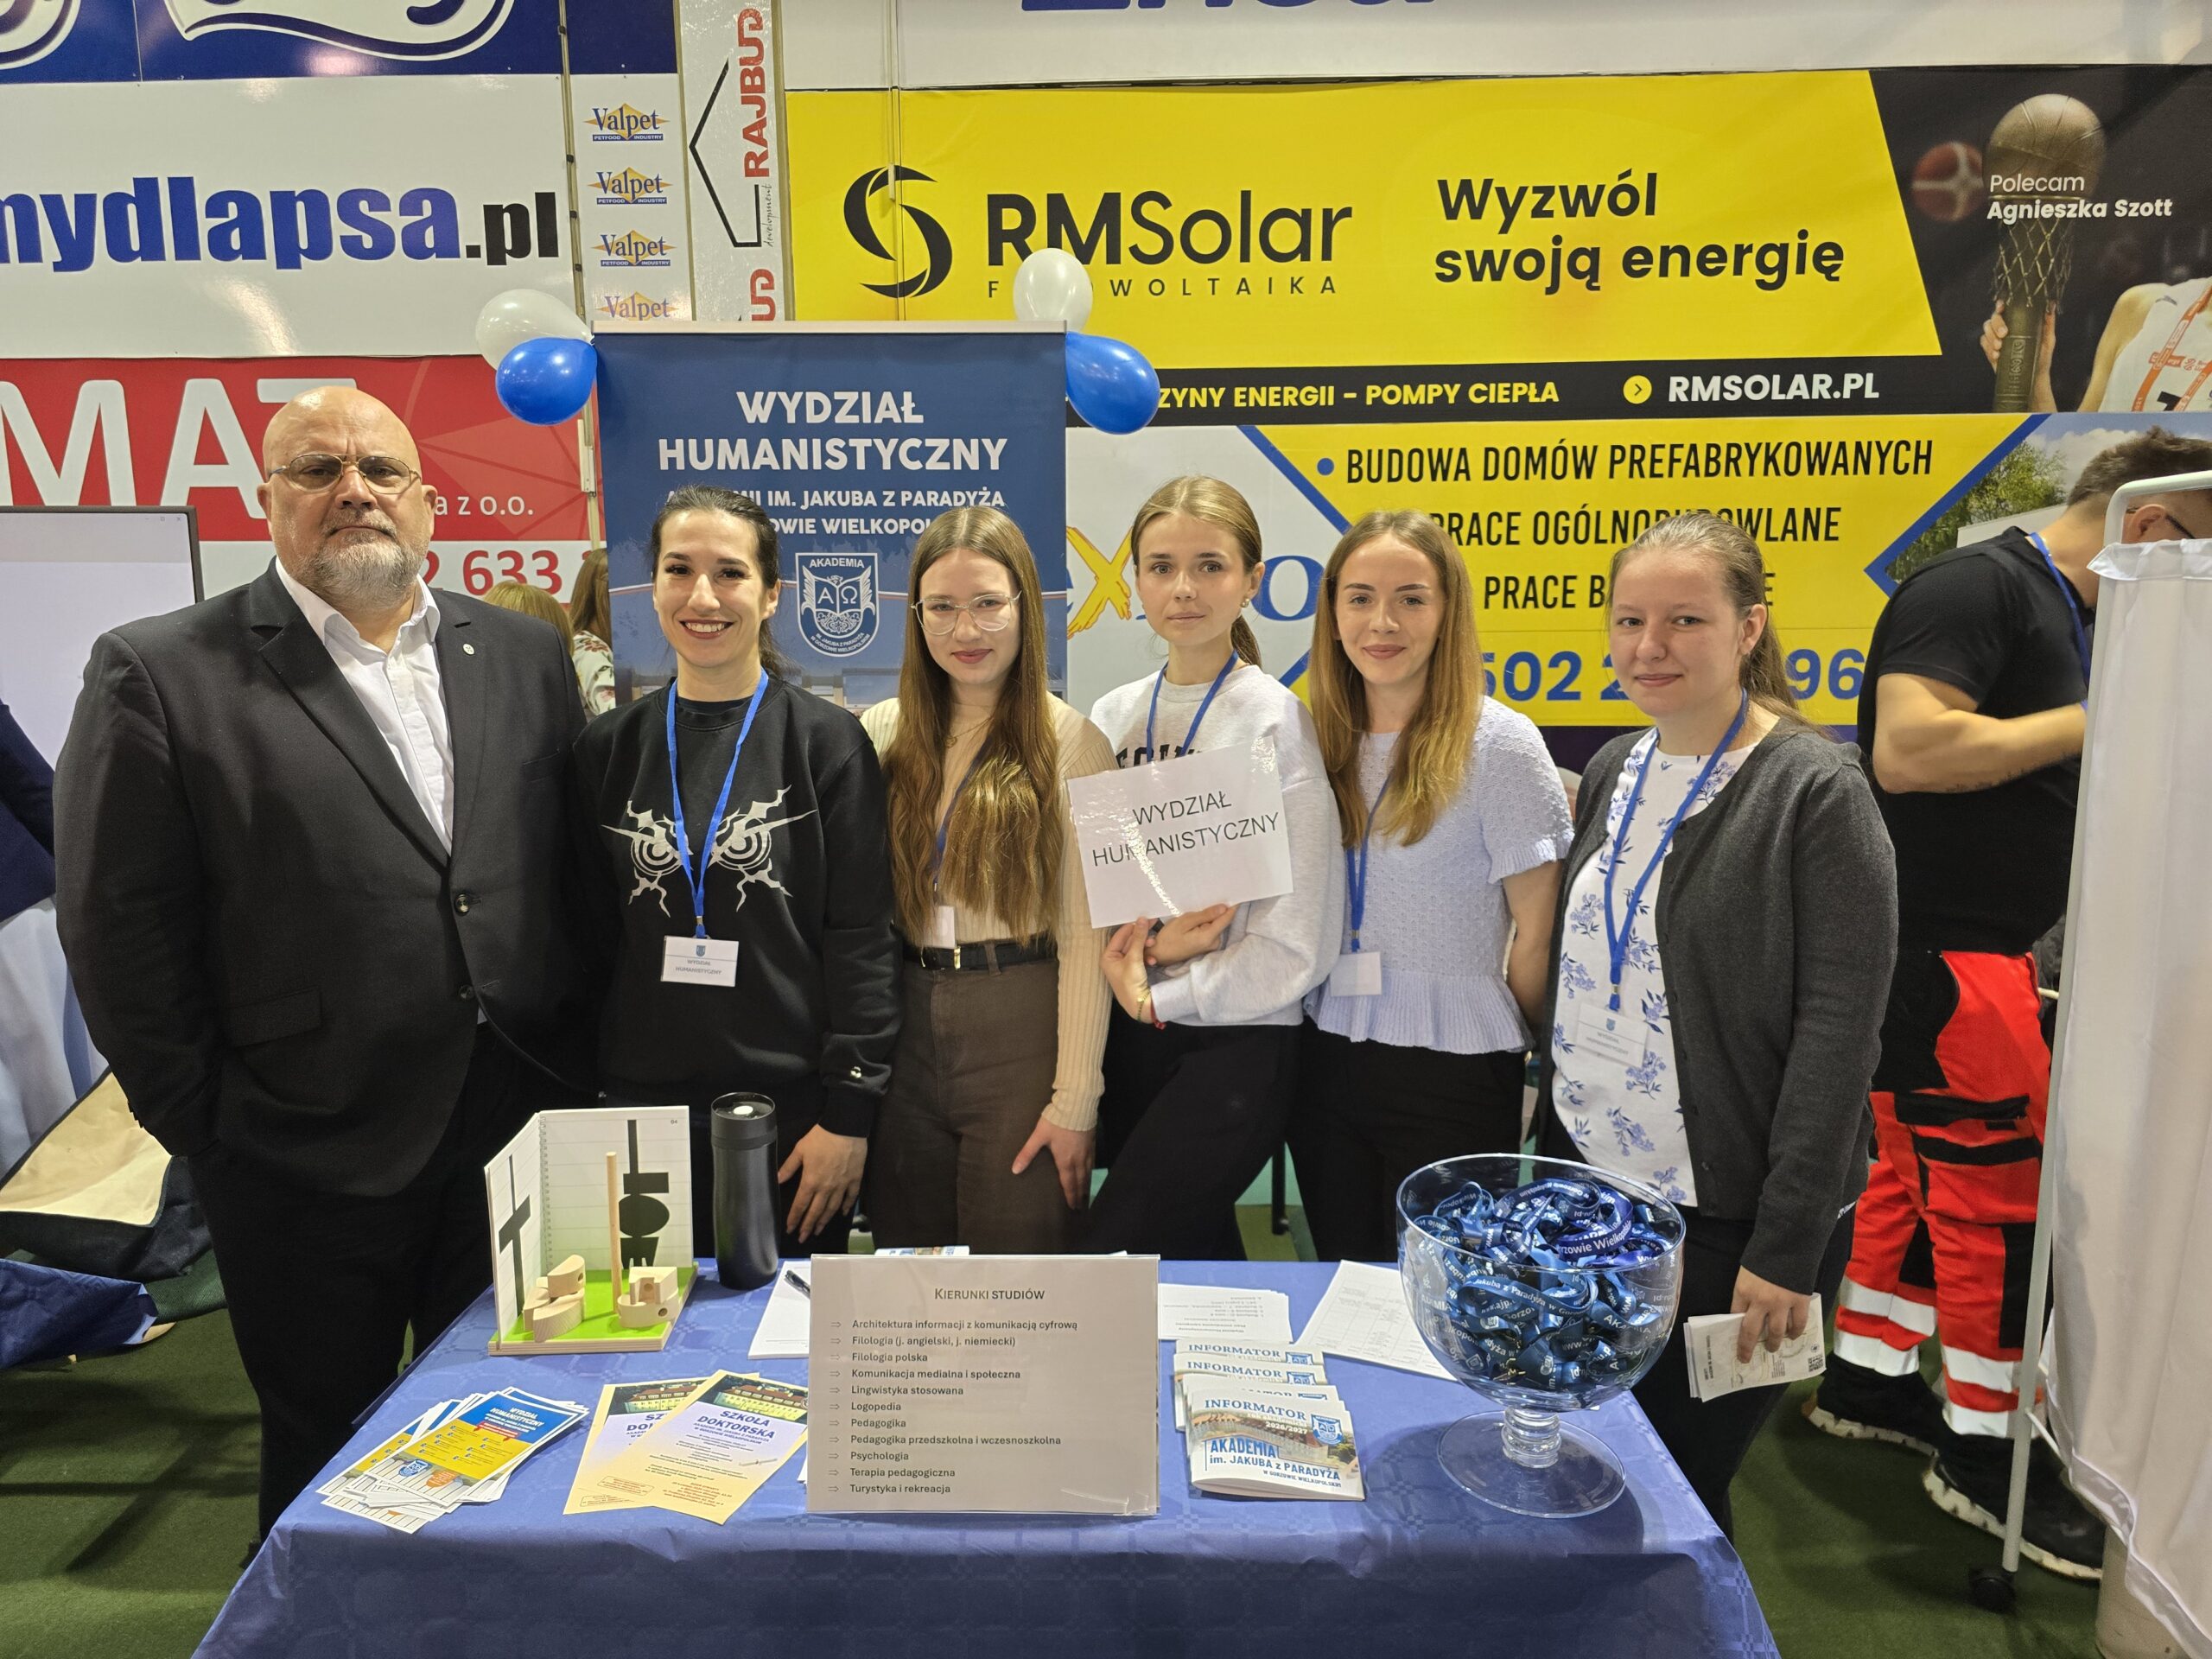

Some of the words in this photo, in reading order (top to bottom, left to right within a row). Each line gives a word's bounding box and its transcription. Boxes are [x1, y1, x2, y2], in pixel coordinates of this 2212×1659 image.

[737, 8, 770, 178] RAJBUD
[593, 107, 659, 139] Valpet
[596, 171, 664, 203] Valpet
[1989, 173, 2086, 194] Polecam
[1438, 169, 1657, 234] Wyzwól
[1986, 197, 2108, 221] Agnieszka
[2113, 196, 2174, 219] Szott
[986, 189, 1353, 266] RMSolar
[601, 234, 668, 266] Valpet
[1434, 237, 1601, 296] swoją
[1621, 228, 1846, 292] energię
[988, 276, 1337, 299] FWOLTAIKA
[605, 296, 671, 321] Valpet
[1234, 385, 1335, 408] ENERGII
[1365, 384, 1461, 406] POMPY
[1468, 381, 1560, 404] CIEPŁA
[1669, 373, 1880, 404] RMSOLAR.PL
[736, 391, 925, 424] WYDZIAŁ
[658, 438, 1008, 471] HUMANISTYCZNY
[1346, 447, 1471, 485] BUDOWA
[1483, 438, 1595, 481] DOMÓW
[1607, 438, 1934, 479] PREFABRYKOWANYCH
[457, 497, 471, 516] z
[480, 496, 535, 516] o.o.
[767, 490, 797, 507] IM.
[800, 490, 878, 510] JAKUBA
[882, 491, 896, 507] Z
[900, 486, 1006, 507] PARADYŻA
[809, 557, 865, 569] AKADEMIA
[1484, 575, 1578, 609] PRACE
[1132, 791, 1232, 825] WYDZIAŁ
[852, 1319, 912, 1330] Architektura
[915, 1319, 965, 1332] informacji
[974, 1319, 1037, 1332] komunikacją
[1039, 1319, 1078, 1332] cyfrową
[852, 1336, 893, 1346] Filologia
[907, 1336, 954, 1346] angielski,
[956, 1337, 962, 1346] j.
[964, 1336, 1016, 1347] niemiecki)
[1188, 1344, 1281, 1357] INFORMATOR
[852, 1352, 893, 1363] Filologia
[895, 1352, 928, 1363] polska
[1187, 1361, 1282, 1377] INFORMATOR
[852, 1369, 915, 1380] Komunikacja
[917, 1369, 963, 1378] medialna
[970, 1369, 1020, 1380] społeczna
[851, 1385, 909, 1396] Lingwistyka
[911, 1387, 964, 1395] stosowana
[720, 1410, 771, 1427] SZKOŁA
[851, 1402, 901, 1413] Logopedia
[1205, 1399, 1307, 1421] INFORMATOR
[697, 1415, 775, 1439] DOKTORSKA
[851, 1418, 906, 1429] Pedagogika
[850, 1434, 906, 1446] Pedagogika
[908, 1434, 974, 1446] przedszkolna
[981, 1434, 1061, 1445] wczesnoszkolna
[1211, 1436, 1277, 1459] AKADEMIA
[850, 1451, 909, 1462] Psychologia
[1210, 1455, 1226, 1464] im.
[1230, 1455, 1273, 1469] JAKUBA
[1284, 1462, 1341, 1481] PARADYŻA
[850, 1468, 886, 1478] Terapia
[887, 1468, 956, 1478] pedagogiczna
[849, 1484, 897, 1495] Turystyka
[905, 1484, 950, 1495] rekreacja
